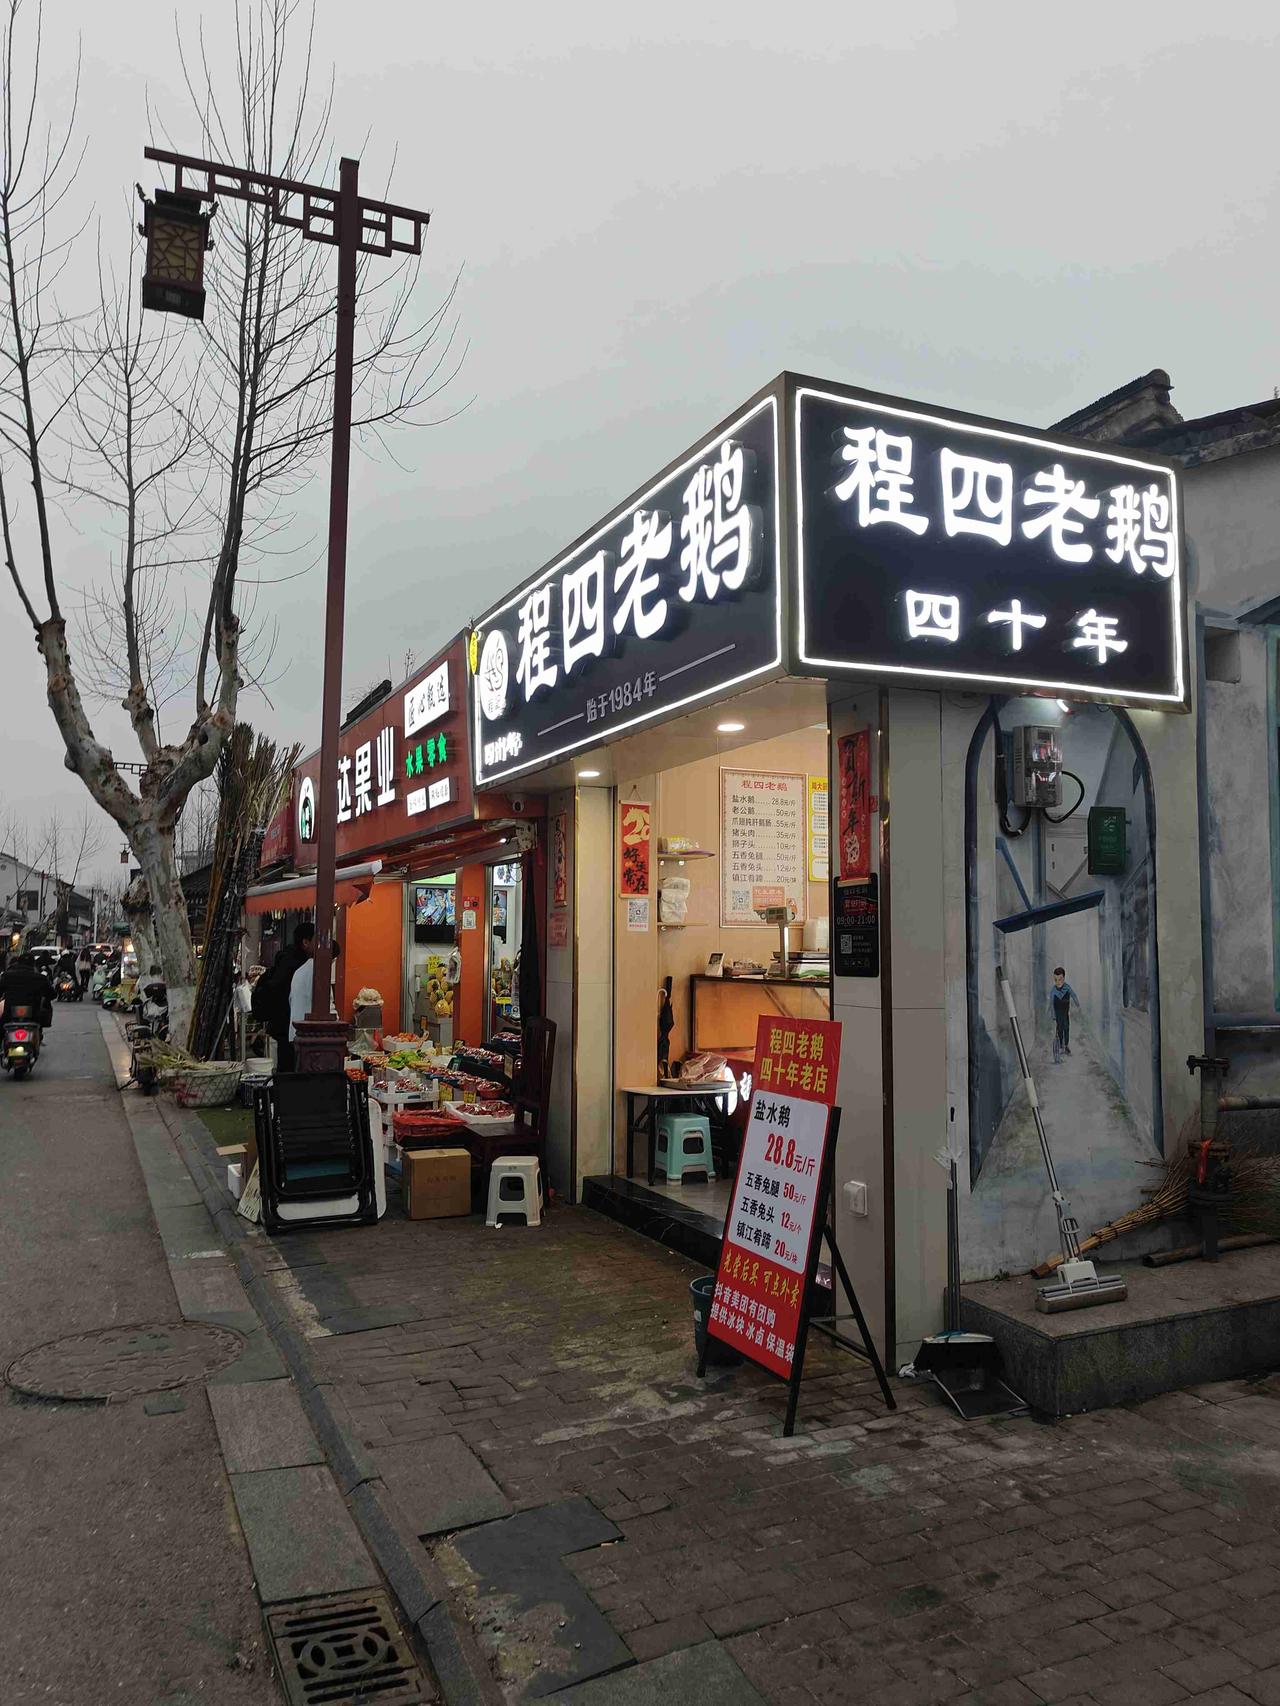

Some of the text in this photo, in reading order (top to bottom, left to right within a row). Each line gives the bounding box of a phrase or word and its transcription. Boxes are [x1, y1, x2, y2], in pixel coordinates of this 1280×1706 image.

[834, 425, 1176, 578] 程四老鹅
[515, 438, 752, 703] 程四老鹅
[904, 588, 1129, 664] 四十年
[585, 671, 658, 724] 始于1984年
[405, 744, 424, 779] 水果
[426, 732, 447, 768] 零食
[732, 795, 755, 804] 盐水鹅
[741, 780, 788, 792] 程四老鹅
[732, 806, 796, 817] 老公鹅 50元/斤
[776, 820, 796, 829] 55元/斤
[732, 829, 796, 840] 猪头肉 35元/斤
[732, 862, 762, 871] 五香兔头
[776, 853, 796, 862] 50元/斤
[769, 1028, 825, 1062] 程四老鹅
[759, 1055, 829, 1094] 四十年老店
[753, 1100, 791, 1128] 盐水鹅
[764, 1133, 816, 1177] 28.8元/斤
[745, 1171, 807, 1206] 五香兔腿 50元/斤
[740, 1196, 802, 1236] 五香兔头 12元/个
[736, 1220, 771, 1251] 镇江肴蹄
[722, 1248, 800, 1309] 先尝后买 可点外卖
[713, 1281, 777, 1328] 抖音美团有团购
[709, 1302, 746, 1336] 提供冰块
[766, 1331, 795, 1364] 保温袋
